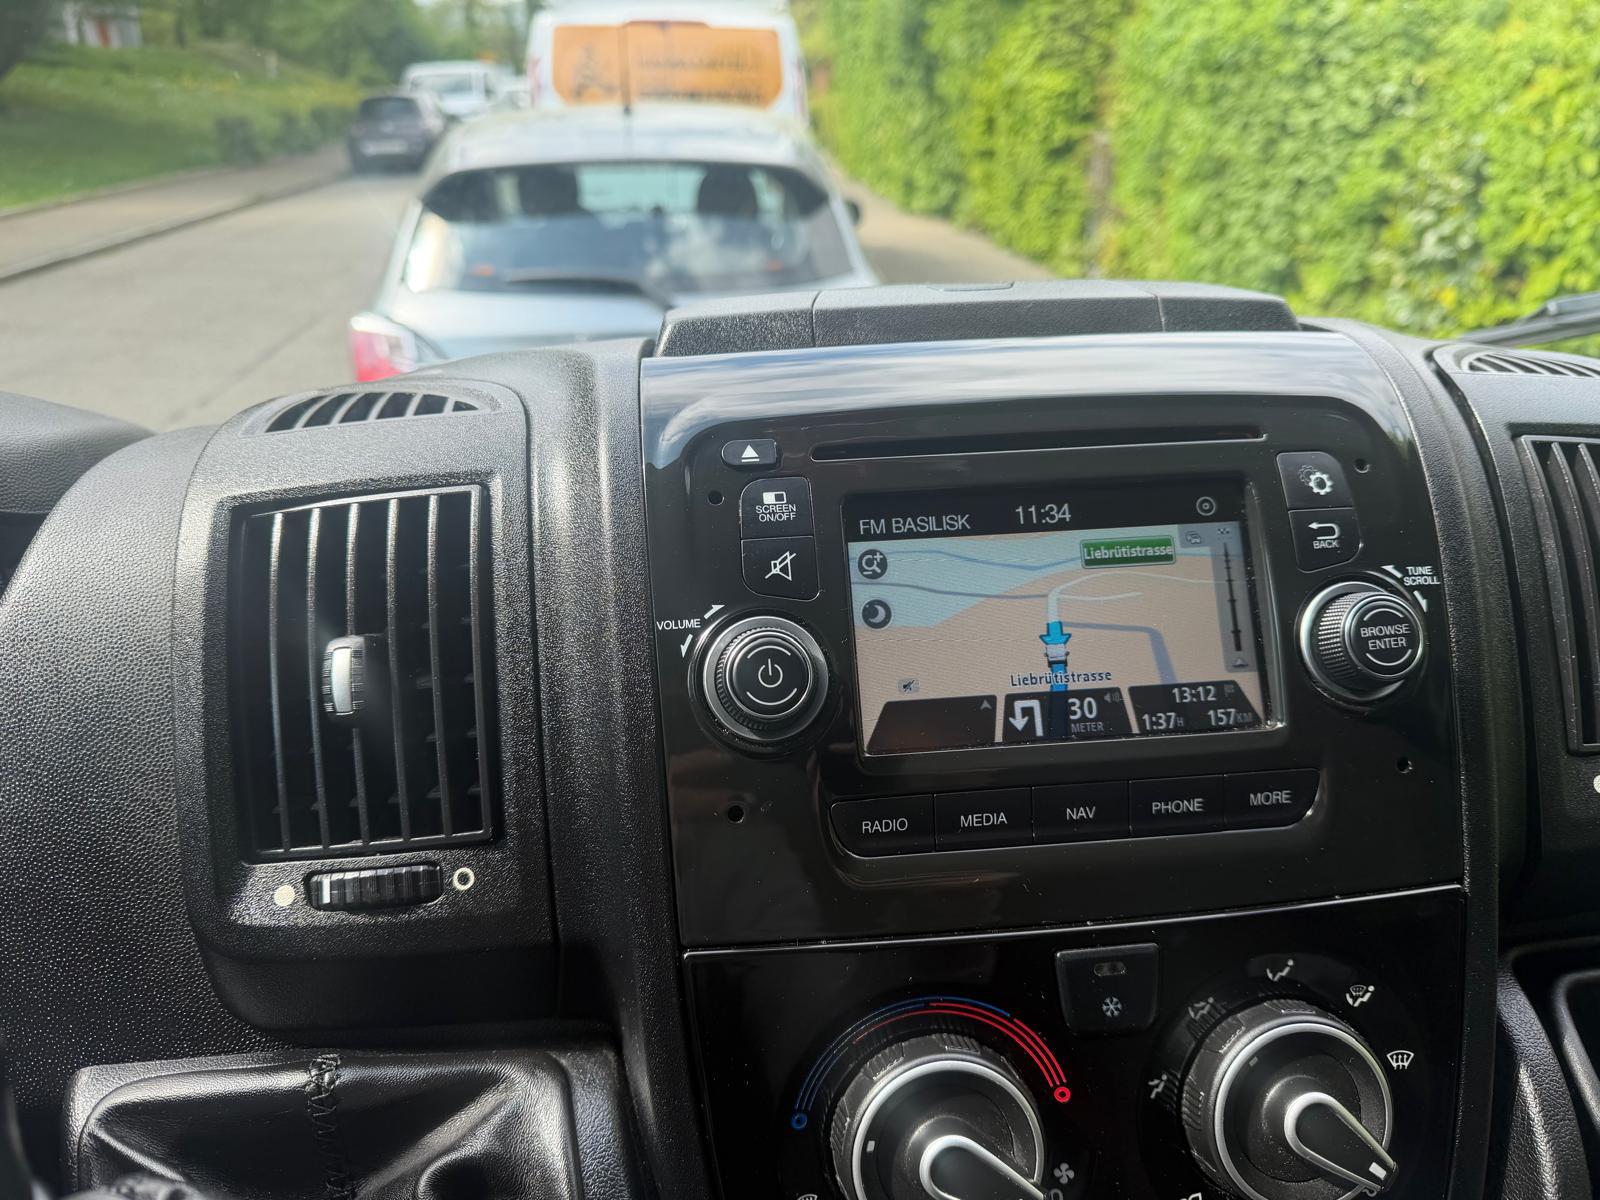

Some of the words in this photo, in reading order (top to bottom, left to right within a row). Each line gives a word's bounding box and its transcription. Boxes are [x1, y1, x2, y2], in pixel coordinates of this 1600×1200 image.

[755, 504, 797, 514] SCREEN
[1015, 503, 1072, 525] 11:34
[758, 512, 797, 523] ON/OFF
[859, 519, 886, 535] FM
[892, 513, 971, 533] BASILISK
[1312, 539, 1340, 550] BACK
[1083, 543, 1174, 562] Liebrütistrasse
[1405, 566, 1433, 576] TUNE
[1403, 575, 1441, 586] SCROLL
[656, 618, 701, 631] VOLUME
[1360, 624, 1411, 637] BROWSE
[1368, 637, 1407, 650] ENTER
[1009, 669, 1112, 687] Liebrütistrasse
[1172, 686, 1216, 703] 13:12
[1067, 697, 1098, 720] 30
[1071, 720, 1104, 734] METER
[1249, 790, 1292, 807] MORE
[1065, 806, 1096, 821] NAV
[1152, 798, 1204, 815] PHONE
[861, 817, 909, 834] RADIO
[959, 812, 1008, 828] MEDIA
